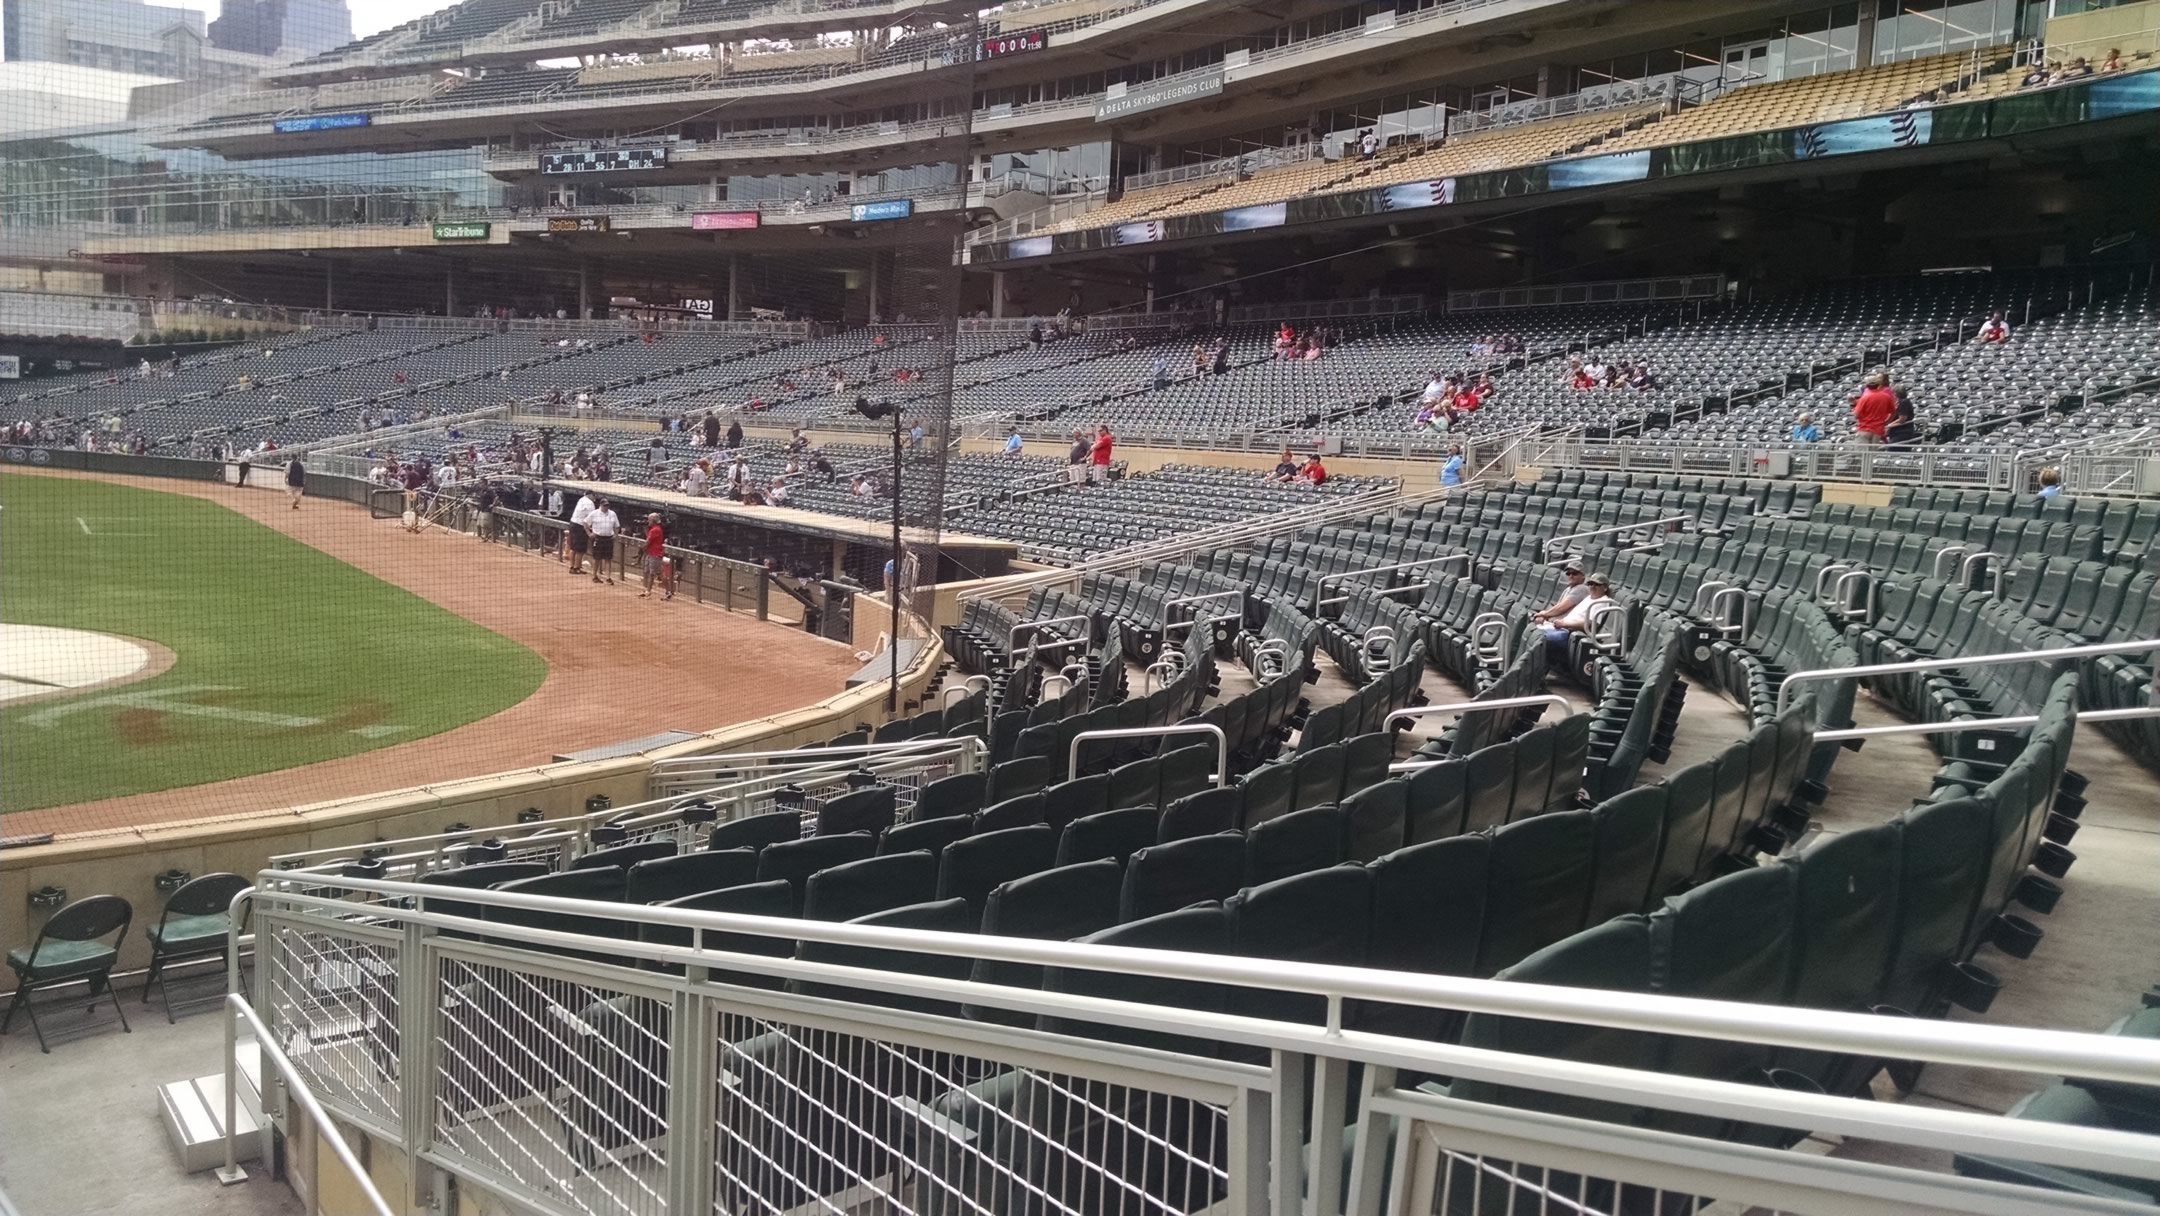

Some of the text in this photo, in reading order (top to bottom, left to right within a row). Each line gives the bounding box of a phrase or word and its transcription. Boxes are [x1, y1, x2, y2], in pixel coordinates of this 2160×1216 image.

[1000, 41, 1006, 53] 0
[1010, 40, 1016, 51] 0
[1021, 38, 1027, 49] 0
[1107, 100, 1131, 114] DELTA
[1163, 84, 1197, 100] LEGENDS
[1199, 77, 1220, 91] CLUB
[546, 163, 552, 173] 2
[562, 162, 573, 173] 2B
[576, 161, 585, 171] 11
[595, 160, 605, 170] SS
[628, 159, 640, 169] DH
[643, 158, 653, 168] 24
